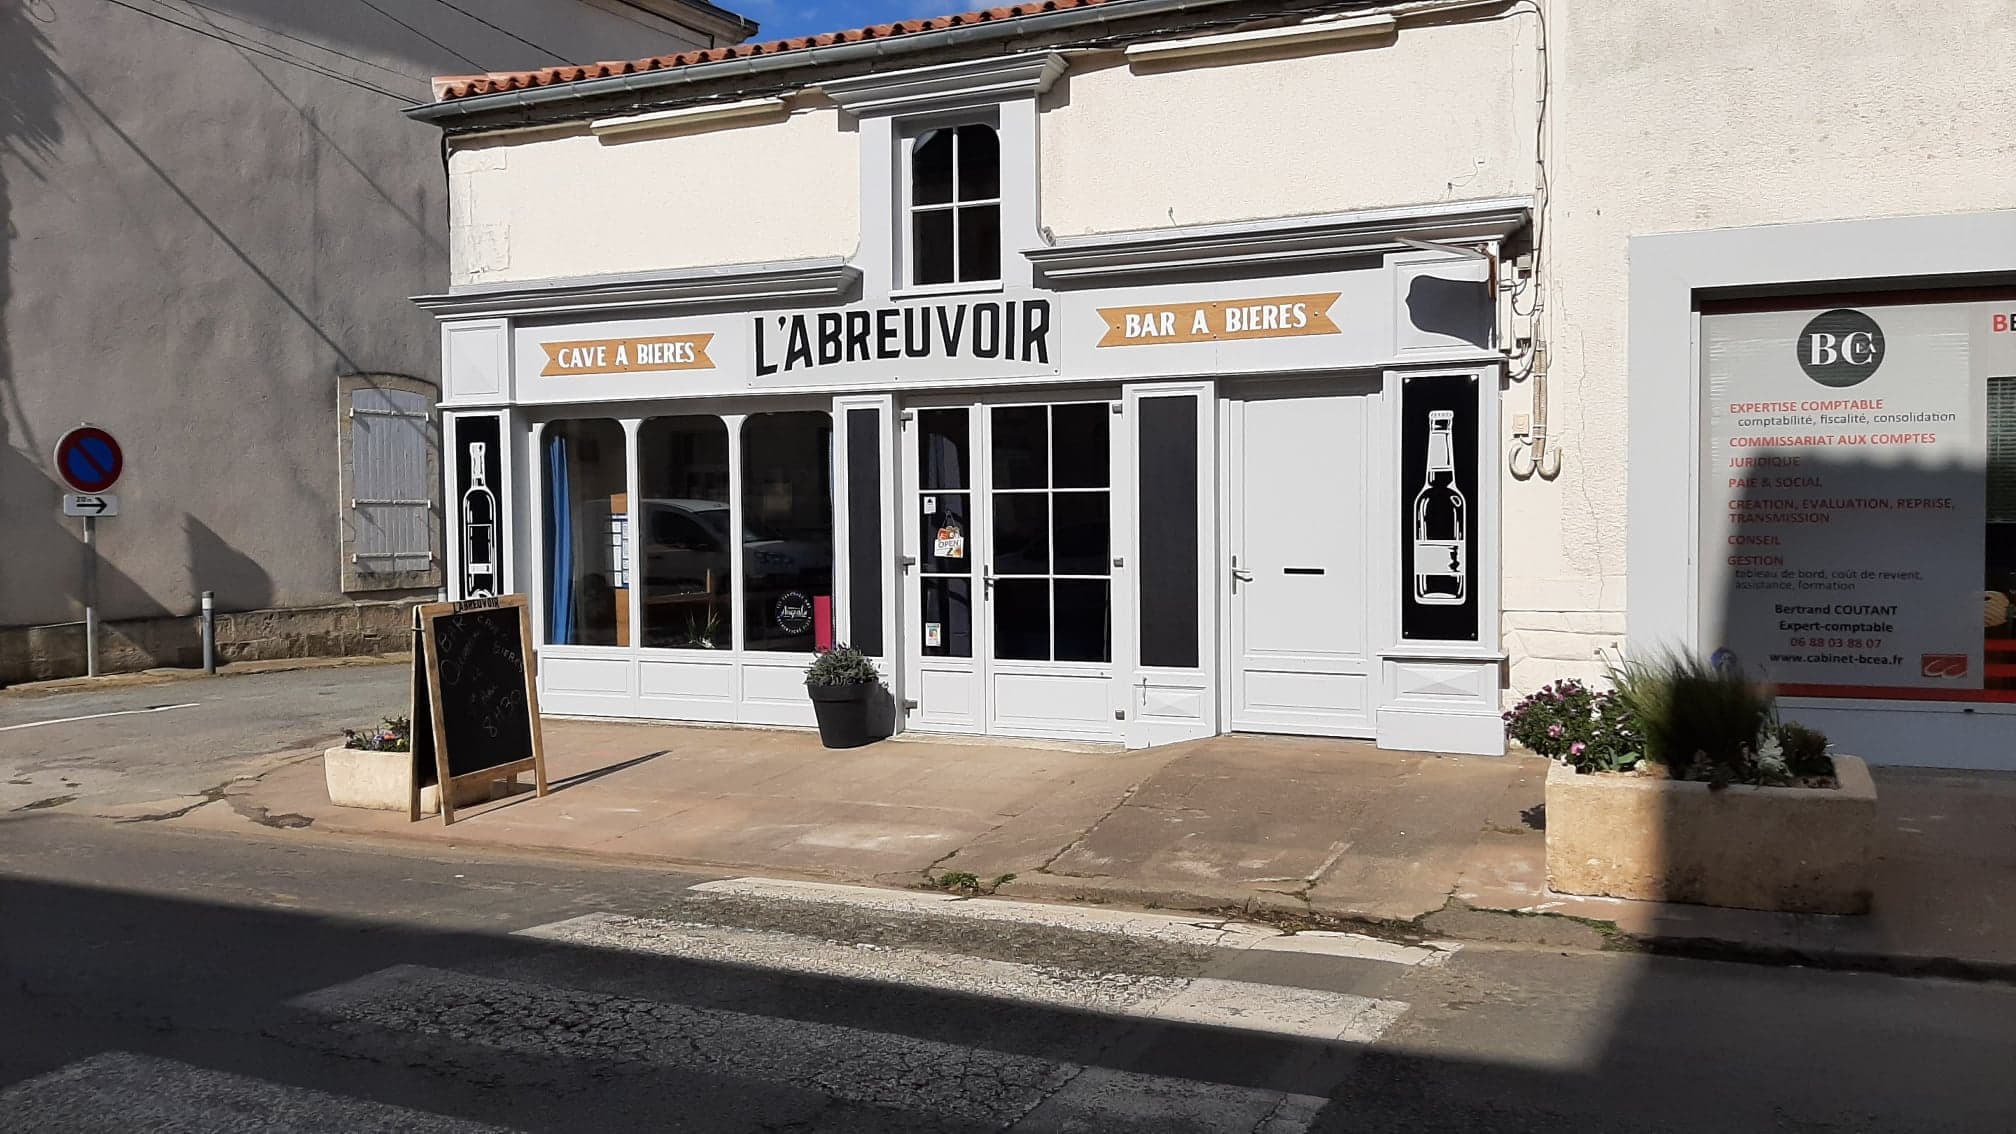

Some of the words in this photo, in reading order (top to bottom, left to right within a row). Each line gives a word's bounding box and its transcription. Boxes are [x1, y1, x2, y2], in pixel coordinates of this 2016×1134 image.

[1125, 311, 1175, 338] BAR
[1191, 309, 1209, 334] A
[1225, 303, 1307, 333] BIERES
[754, 299, 1050, 377] L'ABREUVOIR
[558, 346, 607, 368] CAVE
[616, 345, 629, 366] A
[637, 342, 695, 365] BIERES
[1729, 402, 1797, 414] EXPERTISE
[1800, 399, 1883, 411] COMPTABLE
[1738, 415, 1816, 427] comptabilité,
[1820, 413, 1870, 425] fiscalité,
[1874, 412, 1956, 423] consolidation
[1729, 436, 1834, 447] COMMISSARIAT
[1837, 434, 1867, 445] AUX
[1870, 433, 1936, 444] COMPTES
[1729, 456, 1800, 468] JURIDIQUE
[1729, 478, 1758, 488] PAIE
[1761, 477, 1772, 488] &
[1775, 477, 1822, 488] SOCIAL
[1728, 499, 1799, 511] CREATION,
[1802, 498, 1893, 510] EVALUATION,
[1897, 498, 1956, 510] REPRISE,
[1730, 513, 1830, 523] TRANSMISSION
[938, 539, 960, 549] OPEN
[1728, 535, 1781, 545] CONSEIL
[1727, 555, 1784, 566] GESTION
[1735, 568, 1777, 579] tableau
[1780, 569, 1794, 579] de
[1798, 568, 1828, 580] bord,
[1860, 568, 1875, 579] de
[1878, 569, 1924, 581] revient,
[1798, 580, 1855, 591] formation
[1775, 604, 1831, 615] Bertrand
[1834, 604, 1898, 616] COUTANT
[1779, 620, 1894, 633] Expert-comptable
[1790, 637, 1806, 648] 06
[1809, 637, 1825, 648] 88
[1828, 637, 1843, 648] 03
[1865, 637, 1882, 649] 07
[1769, 652, 1904, 665] www.cabinet-bcea.fr
